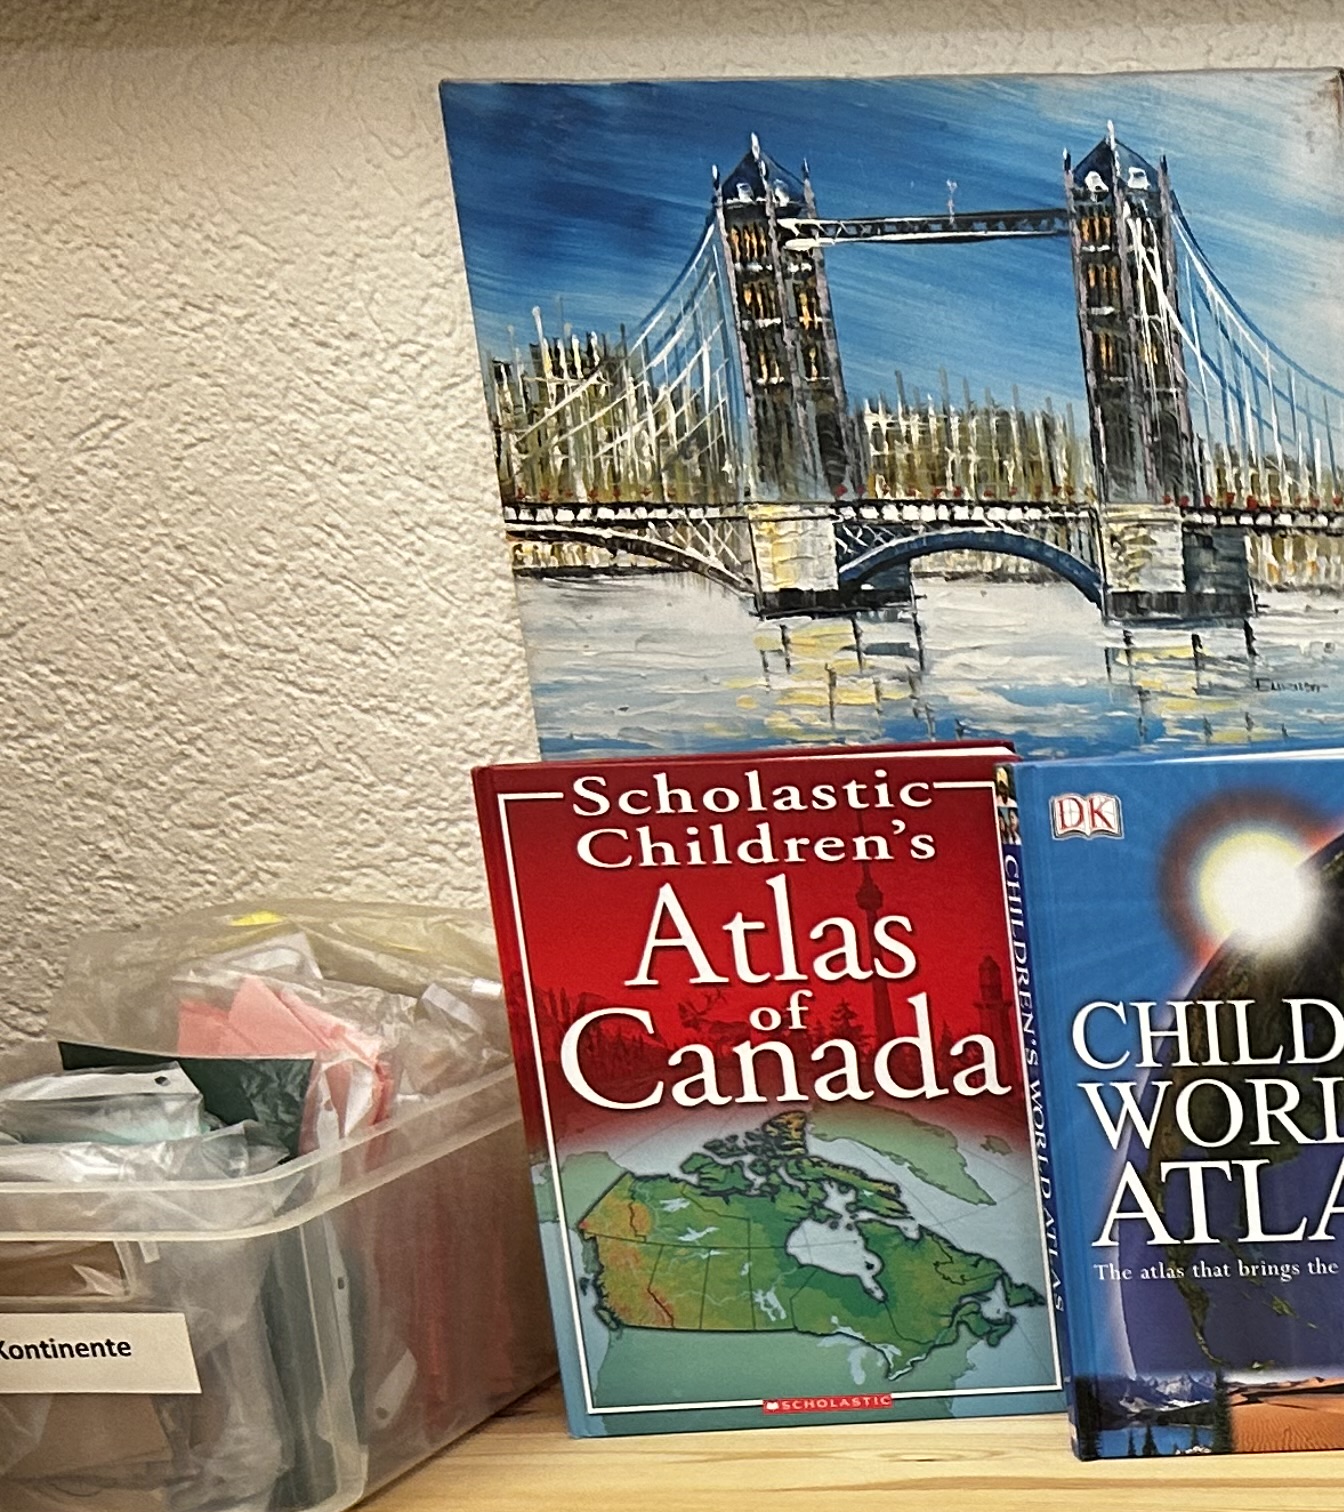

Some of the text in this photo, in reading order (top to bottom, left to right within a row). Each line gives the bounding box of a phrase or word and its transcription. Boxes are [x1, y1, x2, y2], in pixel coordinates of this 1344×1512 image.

[572, 769, 933, 817] Scholastic
[1057, 796, 1115, 830] DK
[576, 819, 937, 869] Children's
[624, 873, 917, 987] Atlas
[750, 989, 813, 1031] of
[559, 992, 1012, 1110] Canada
[1004, 854, 1065, 1313] CHILDREN'S WORLD ATLAS
[1093, 1262, 1132, 1281] The
[1140, 1261, 1185, 1280] atlas
[1192, 1260, 1232, 1279] that
[1238, 1258, 1300, 1283] brings
[1307, 1257, 1340, 1276] the
[781, 1395, 892, 1411] SCHOLASTIC
